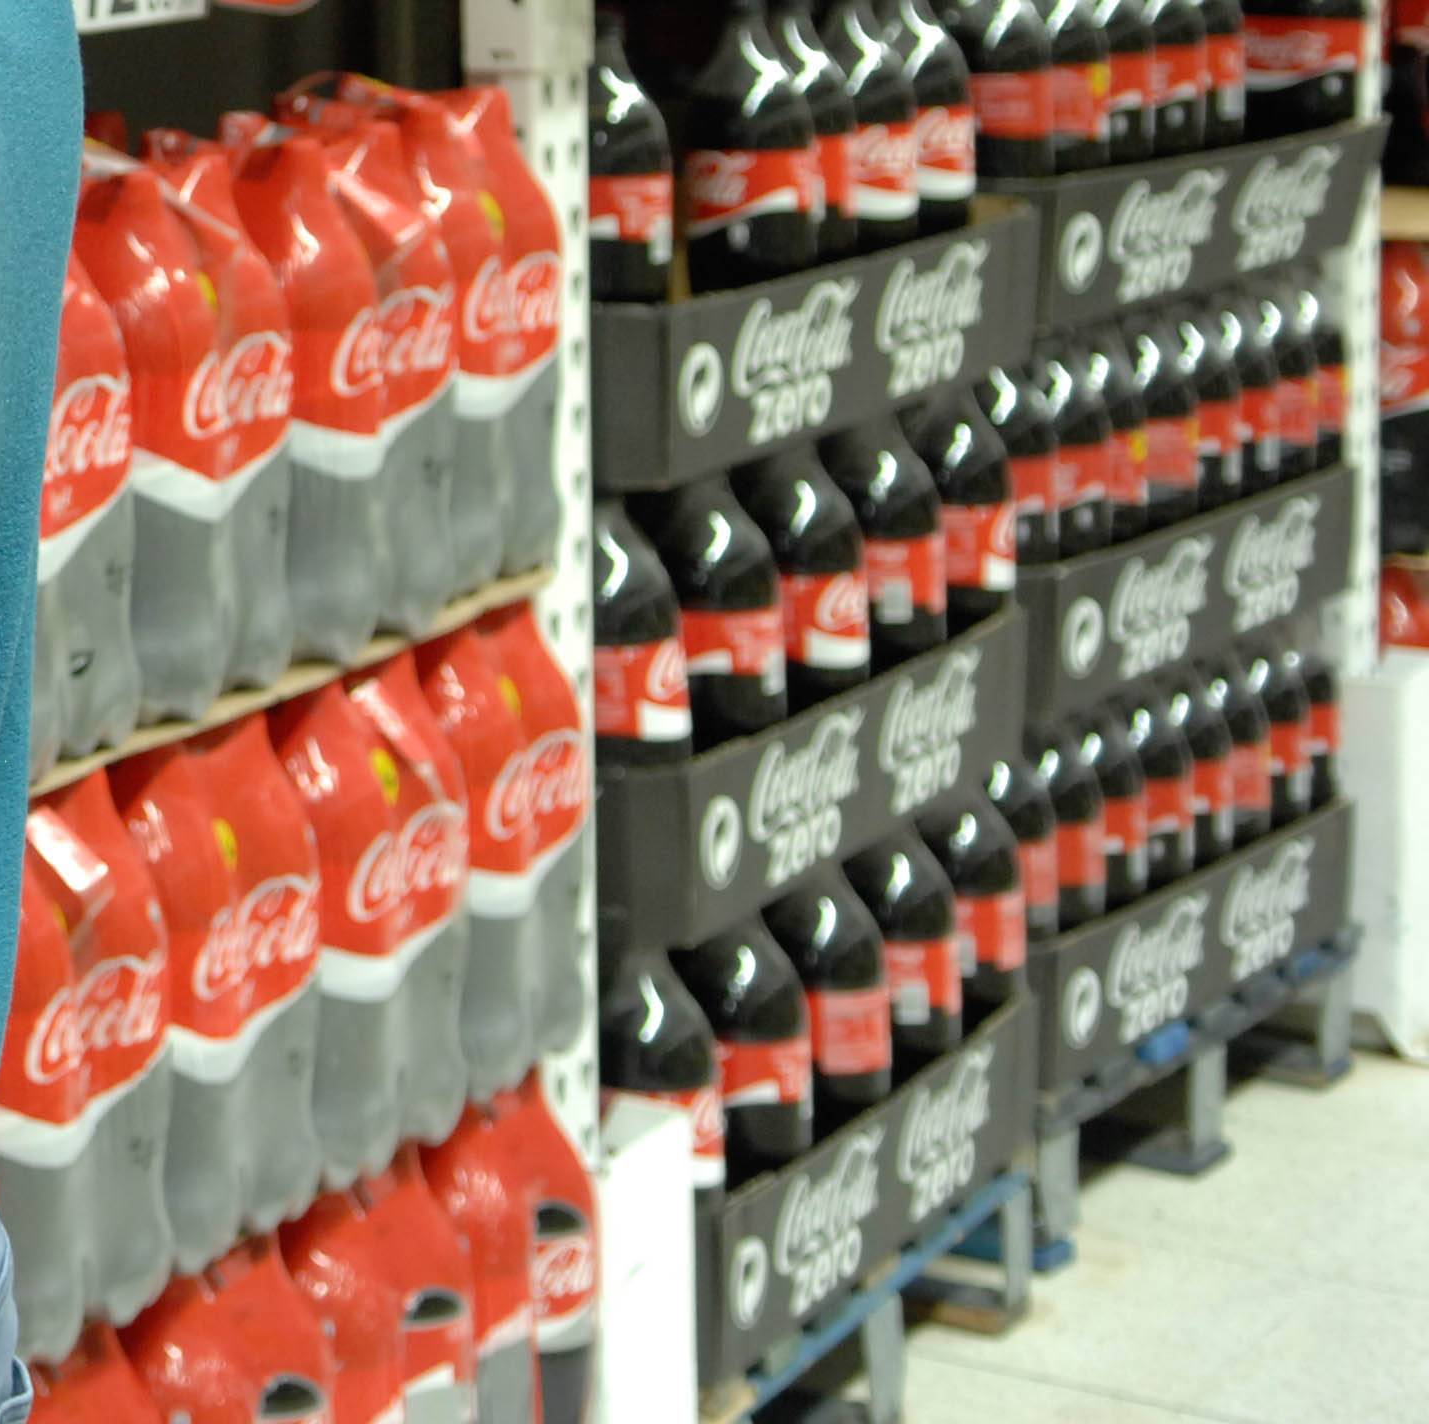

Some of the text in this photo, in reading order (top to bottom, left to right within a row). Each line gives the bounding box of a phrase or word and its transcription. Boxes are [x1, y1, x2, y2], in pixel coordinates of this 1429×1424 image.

[1108, 168, 1225, 263] Coca-Cola
[877, 237, 990, 358] Coca-Cola
[1116, 248, 1192, 305] zero
[733, 274, 860, 398] Coca-Cola
[889, 333, 964, 401] zero
[746, 376, 833, 446] zero
[1108, 535, 1216, 644] Coca-Cola
[1117, 618, 1191, 681] zero
[879, 645, 984, 776] Coca-Cola
[749, 705, 865, 844] Coca-Cola
[891, 741, 961, 816] zero
[765, 806, 841, 888] zero
[776, 1123, 884, 1274] Coca-Cola
[790, 1226, 862, 1318] zero
